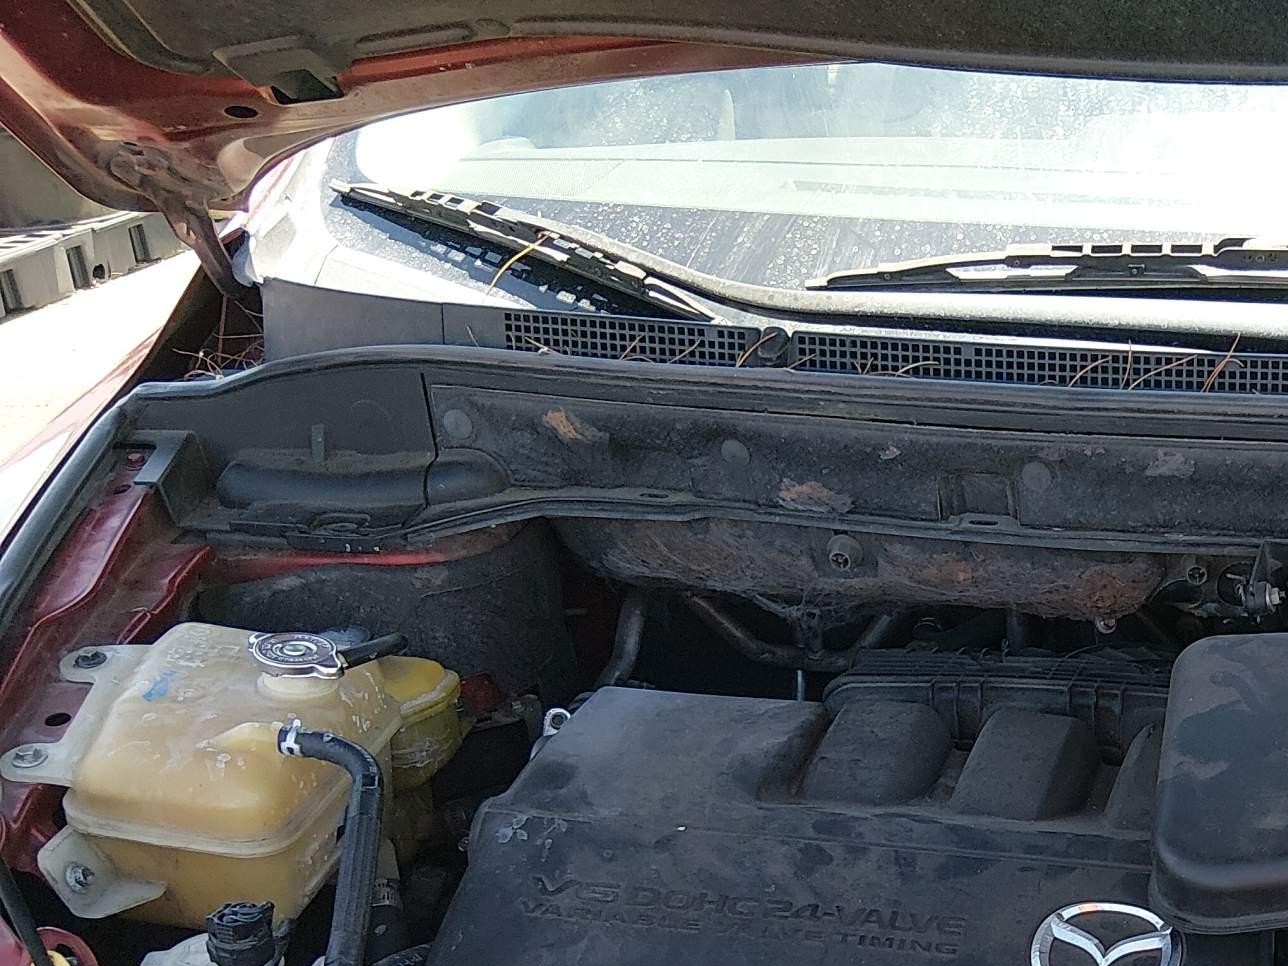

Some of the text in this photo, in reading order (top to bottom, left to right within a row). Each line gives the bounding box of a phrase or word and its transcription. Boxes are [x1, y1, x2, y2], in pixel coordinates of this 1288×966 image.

[532, 876, 968, 936] V6 DOHC 24-VALVE
[833, 931, 963, 957] TIMING
